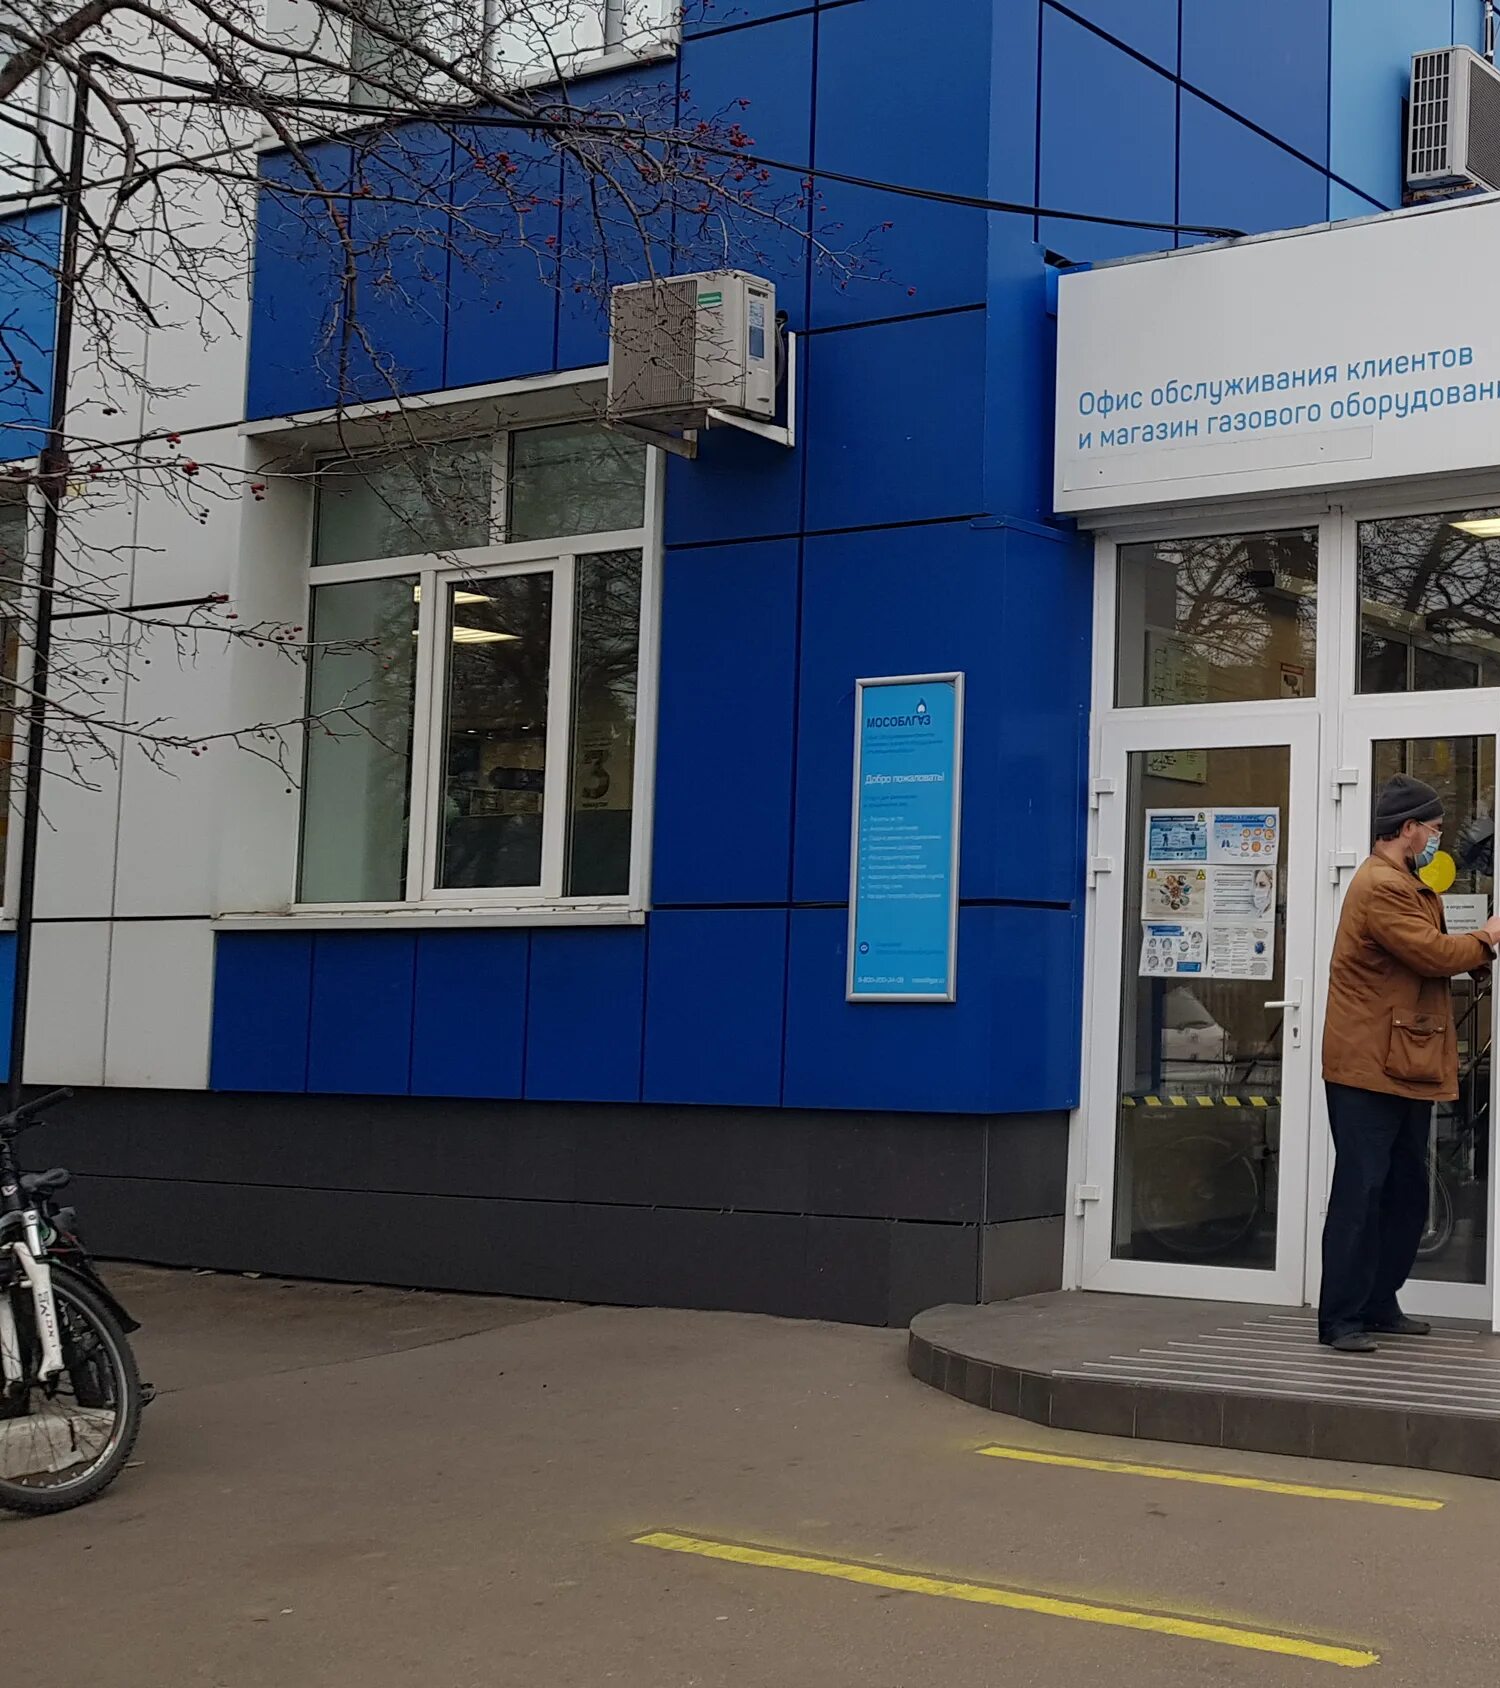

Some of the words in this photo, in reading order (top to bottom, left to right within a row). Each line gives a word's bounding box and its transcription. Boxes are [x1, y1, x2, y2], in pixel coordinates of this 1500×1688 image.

[1079, 389, 1143, 419] Офис
[1151, 365, 1337, 405] обслуживания
[1347, 346, 1473, 381] клиентов
[1078, 432, 1092, 450] и
[1100, 418, 1198, 447] магазин
[1207, 403, 1321, 434] газового
[866, 714, 931, 728] МОСОБЛГАЗ
